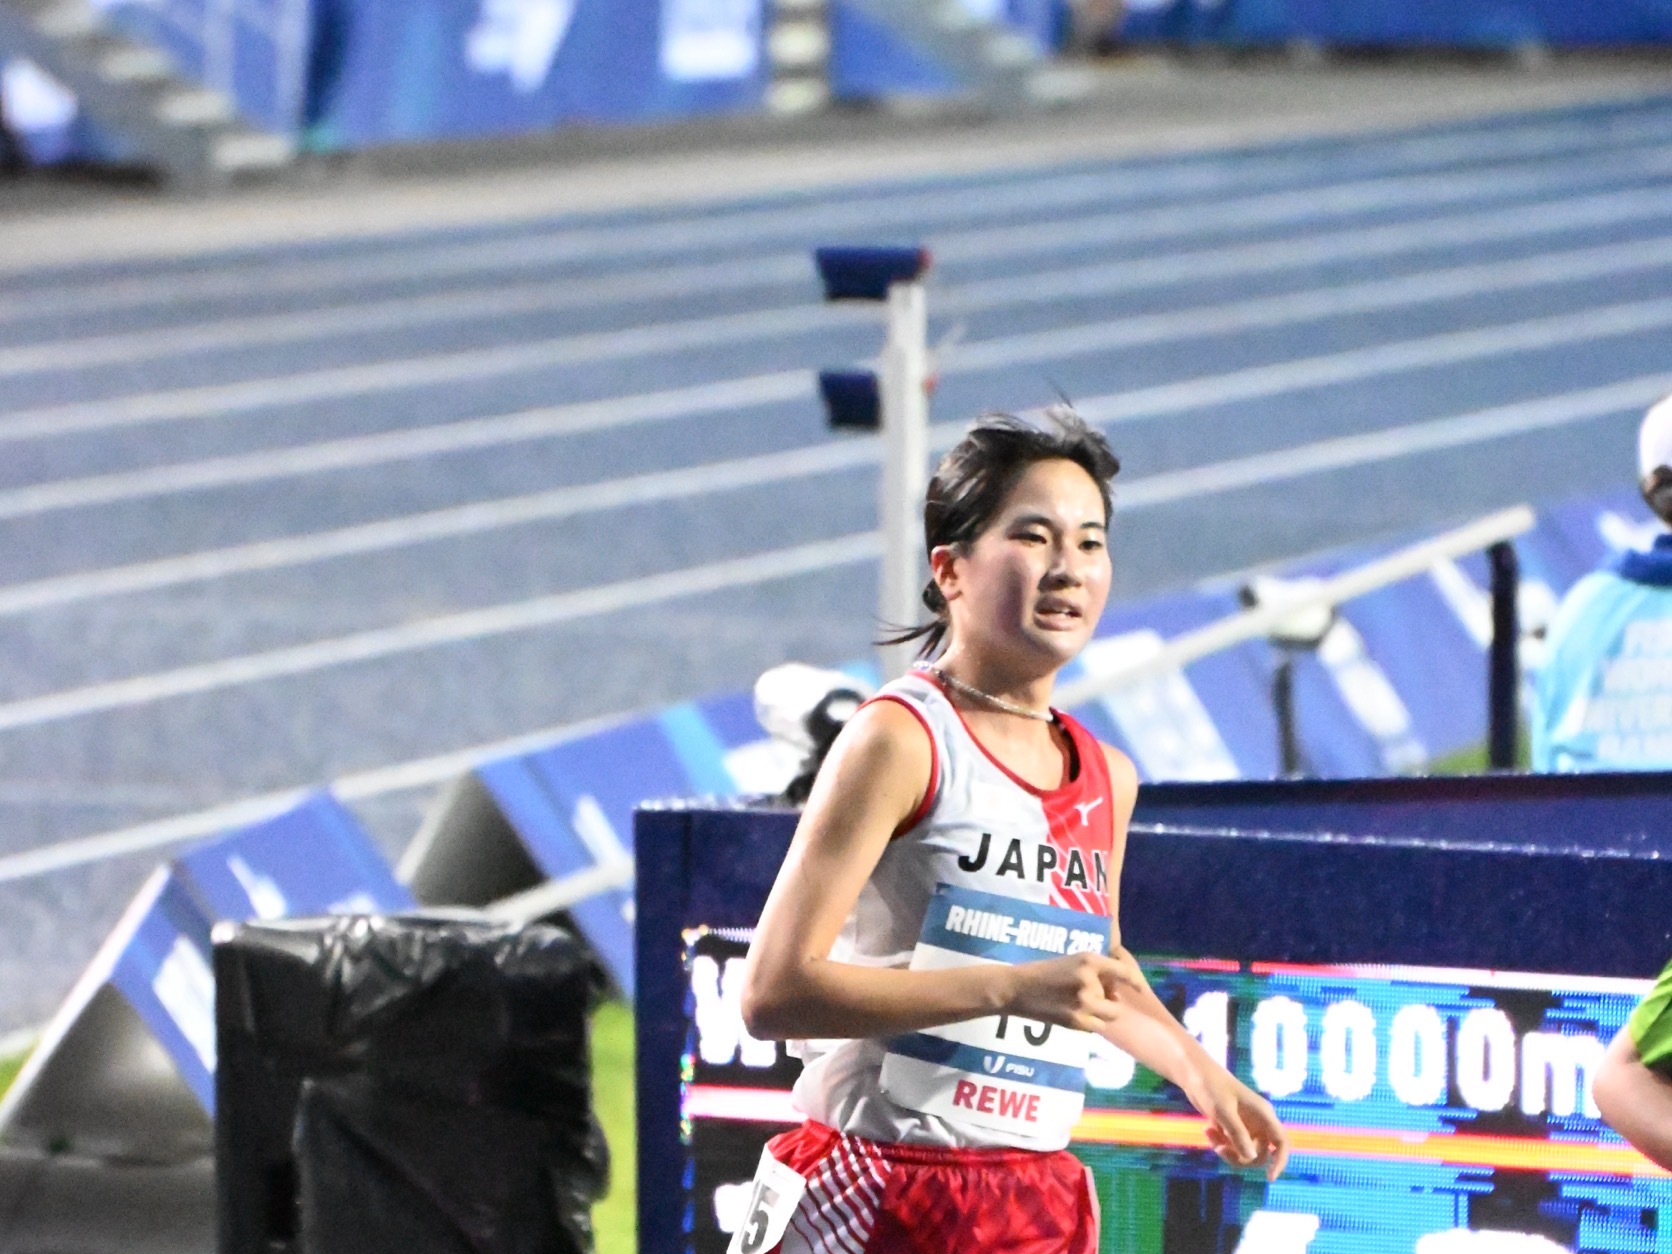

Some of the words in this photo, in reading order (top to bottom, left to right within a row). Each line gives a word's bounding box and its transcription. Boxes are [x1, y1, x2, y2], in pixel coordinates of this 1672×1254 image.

[957, 832, 1109, 894] JAPAN
[945, 904, 1068, 955] RHINE-RUHR
[1183, 990, 1606, 1118] 10000m
[952, 1079, 1041, 1123] REWE
